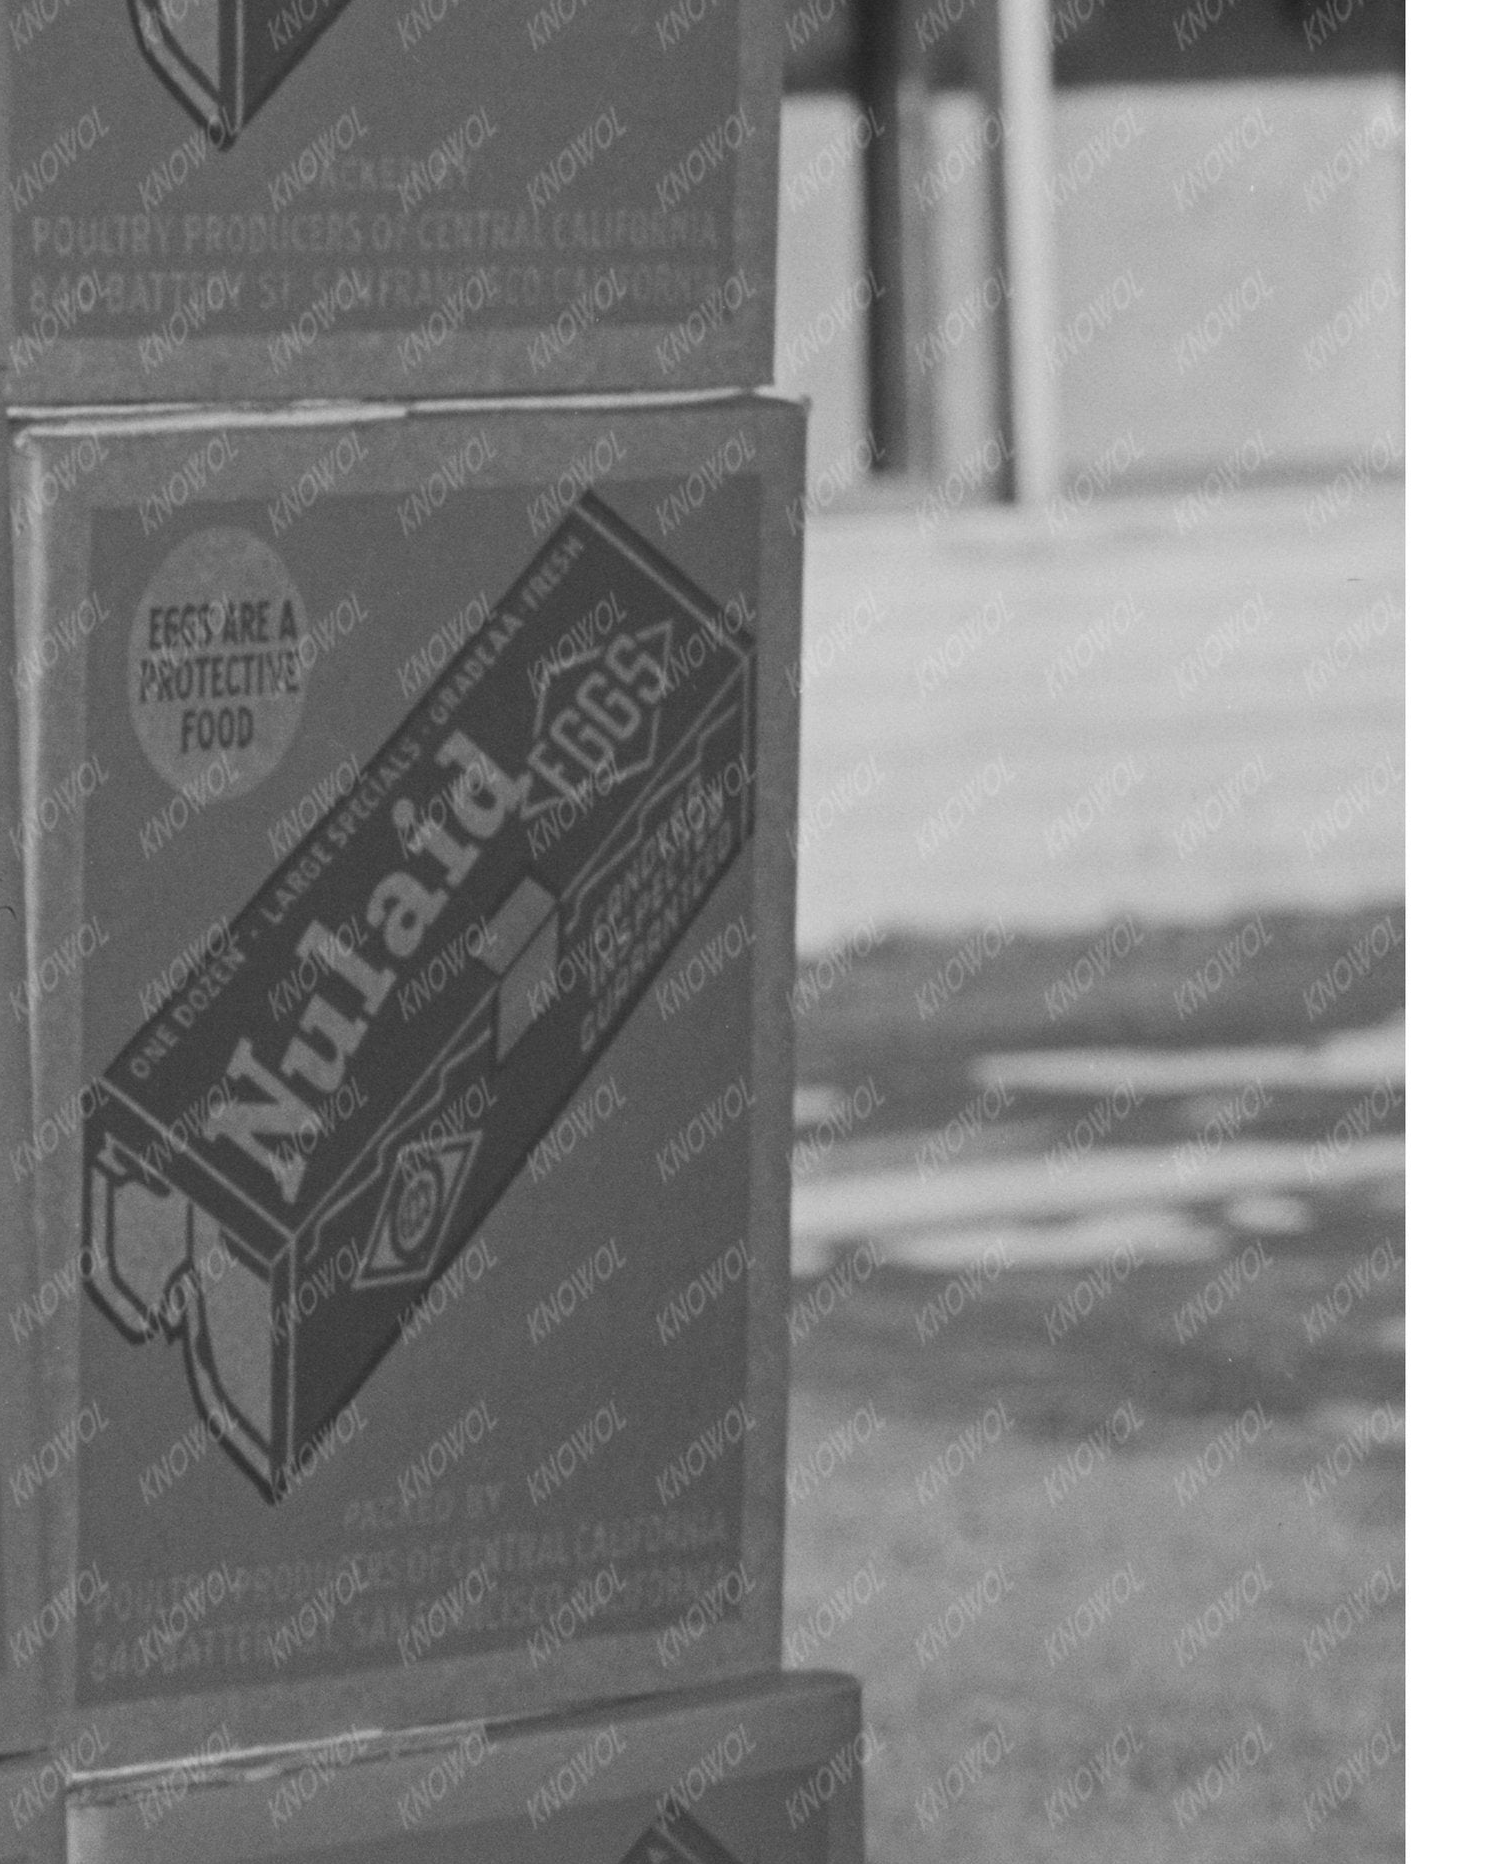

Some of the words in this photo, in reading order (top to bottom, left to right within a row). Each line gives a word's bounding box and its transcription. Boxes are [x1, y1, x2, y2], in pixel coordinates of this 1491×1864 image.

[148, 603, 213, 650] EGGS
[222, 601, 271, 646] ARE
[278, 599, 299, 642] A
[139, 649, 300, 704] PROTECTIVE
[180, 709, 255, 755] FOOD
[529, 634, 668, 802] EGGS
[202, 731, 532, 1204] Nulaid
